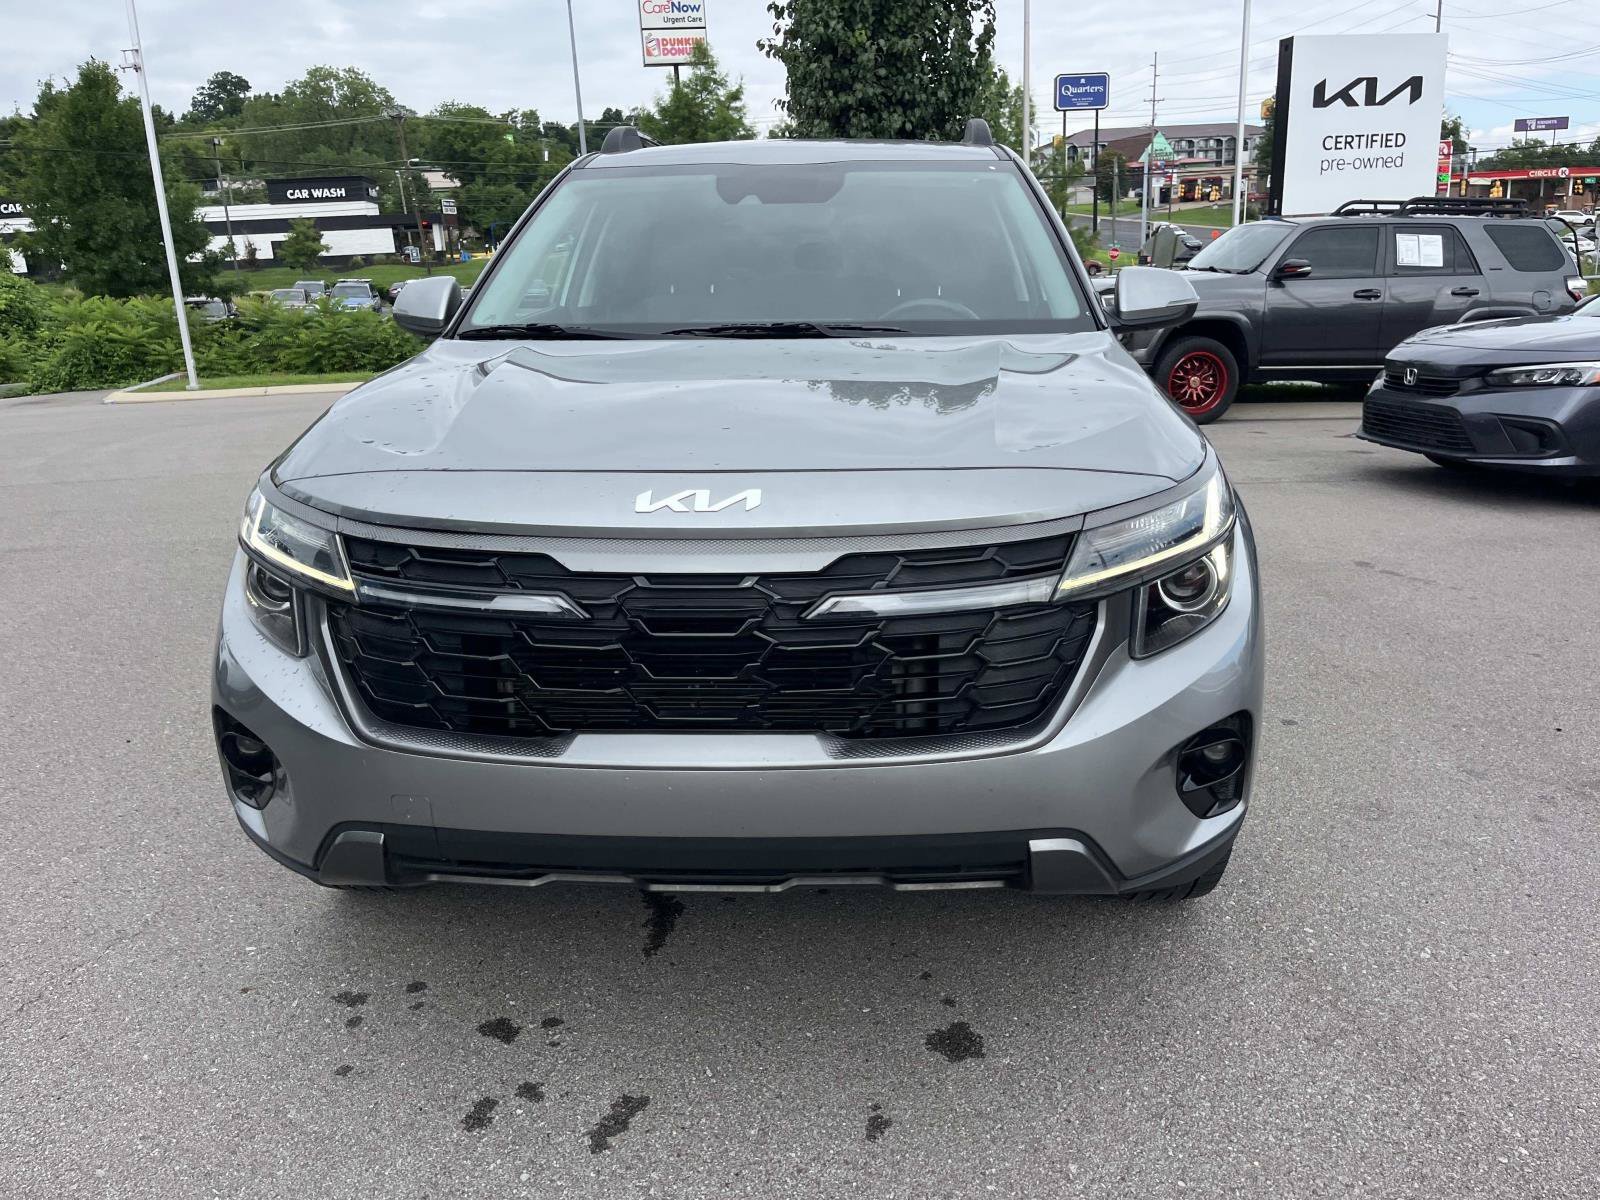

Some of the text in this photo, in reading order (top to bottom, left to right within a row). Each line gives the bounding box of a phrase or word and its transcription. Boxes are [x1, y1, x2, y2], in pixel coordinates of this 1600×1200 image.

[642, 0, 701, 14] CareNow
[663, 16, 686, 24] Urgent
[1061, 84, 1104, 97] Quarters
[1322, 132, 1407, 151] CERTIFIED
[1320, 152, 1404, 176] pre-owned
[1528, 170, 1557, 178] CIRCLE
[286, 187, 346, 200] CAR WASH
[0, 203, 24, 214] CAR
